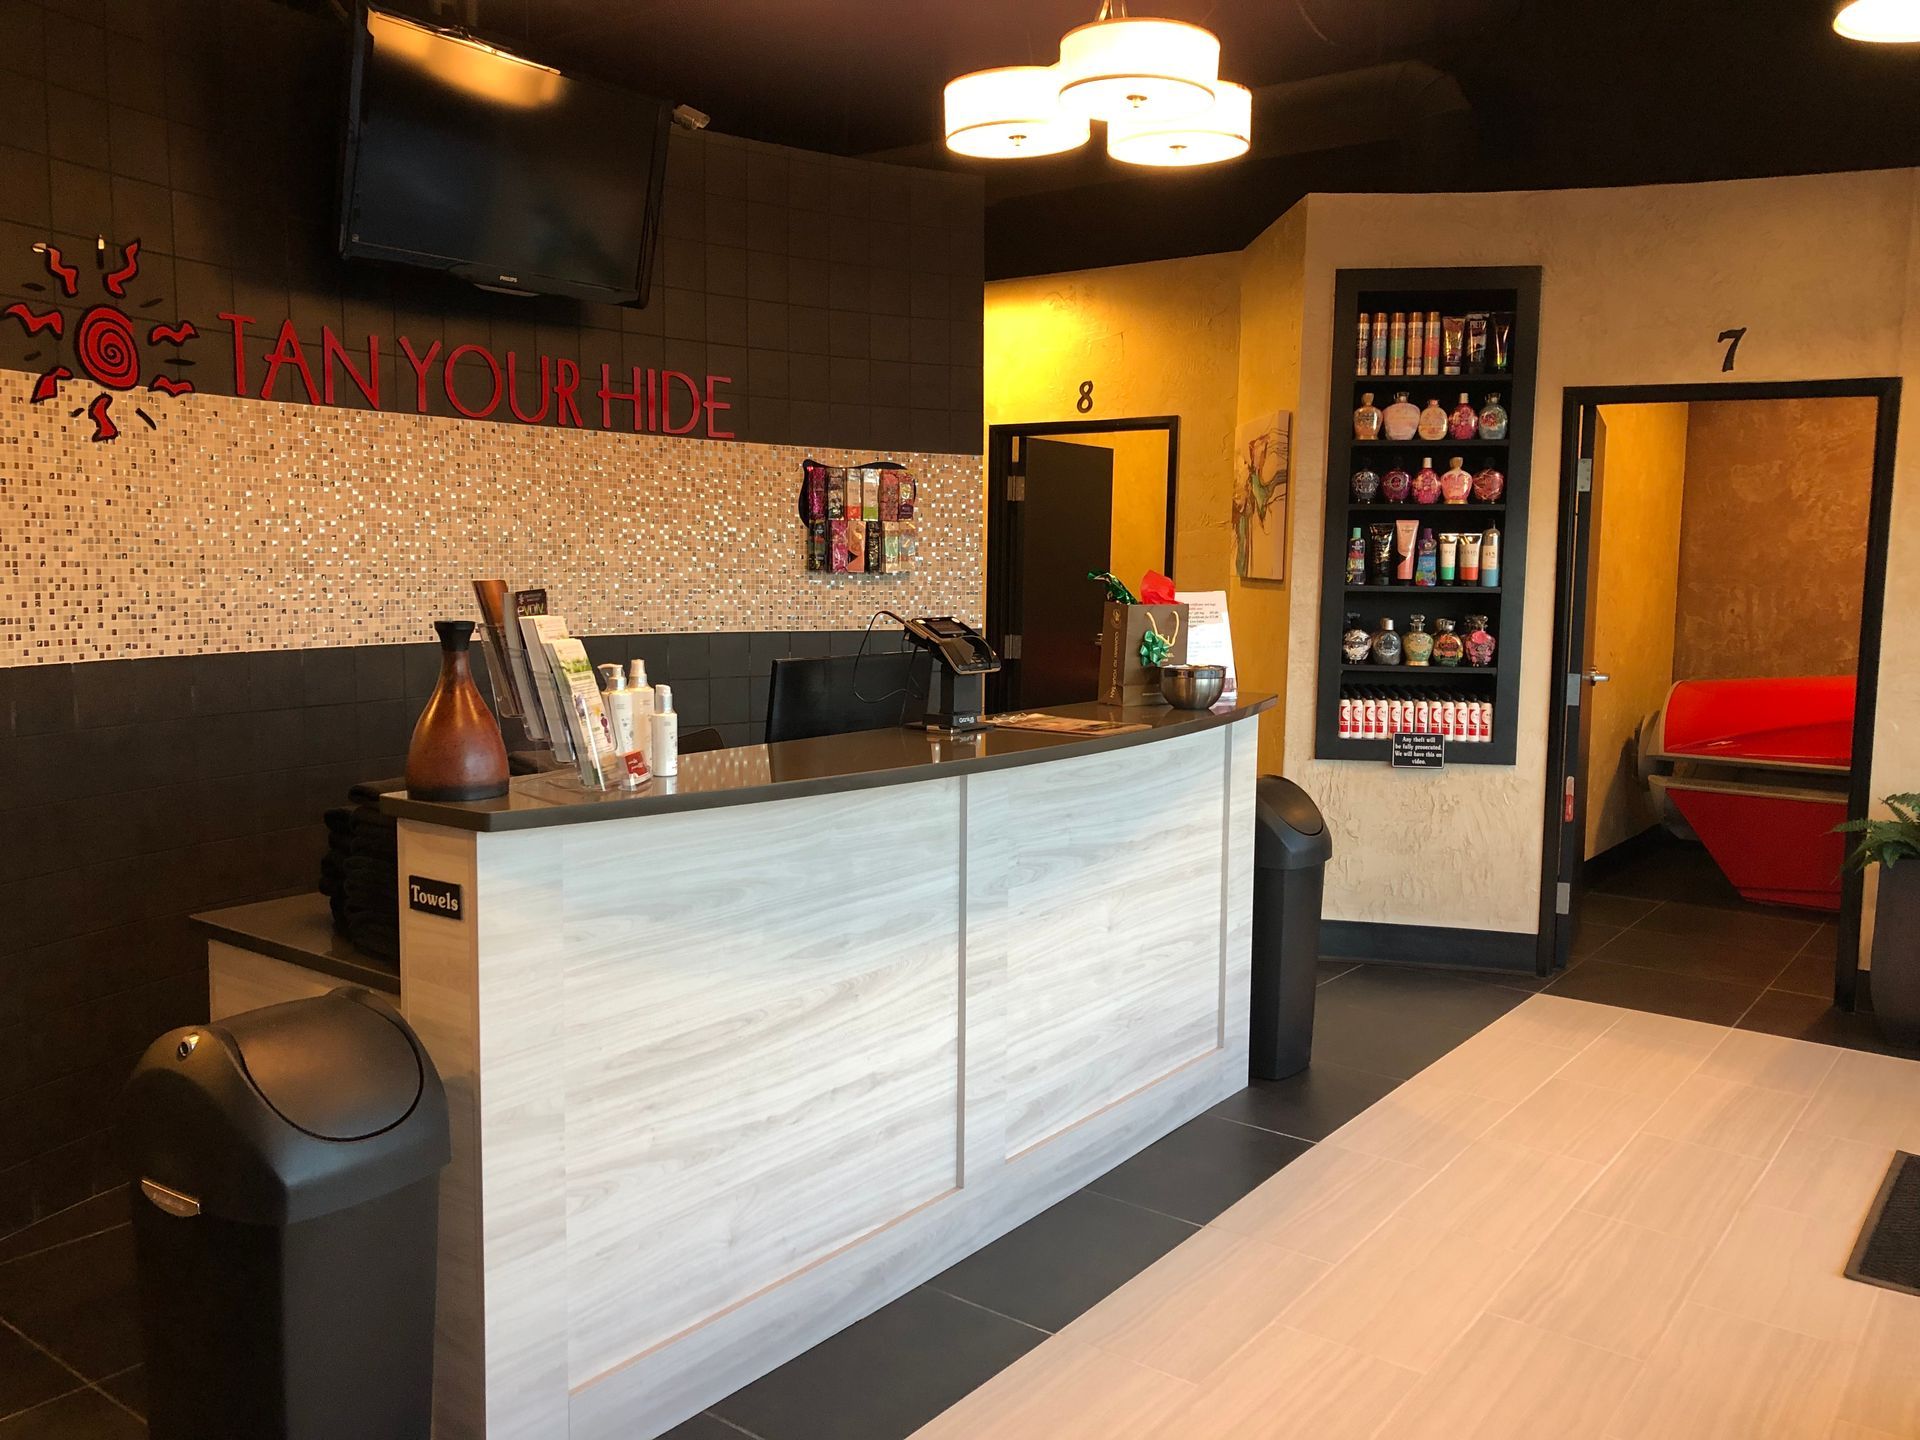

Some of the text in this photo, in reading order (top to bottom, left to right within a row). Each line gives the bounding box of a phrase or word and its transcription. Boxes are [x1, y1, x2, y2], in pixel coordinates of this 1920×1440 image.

[1717, 327, 1747, 372] 7
[217, 312, 735, 439] TAN YOUR HIDE
[1076, 380, 1094, 414] 8
[410, 884, 459, 911] Towels
